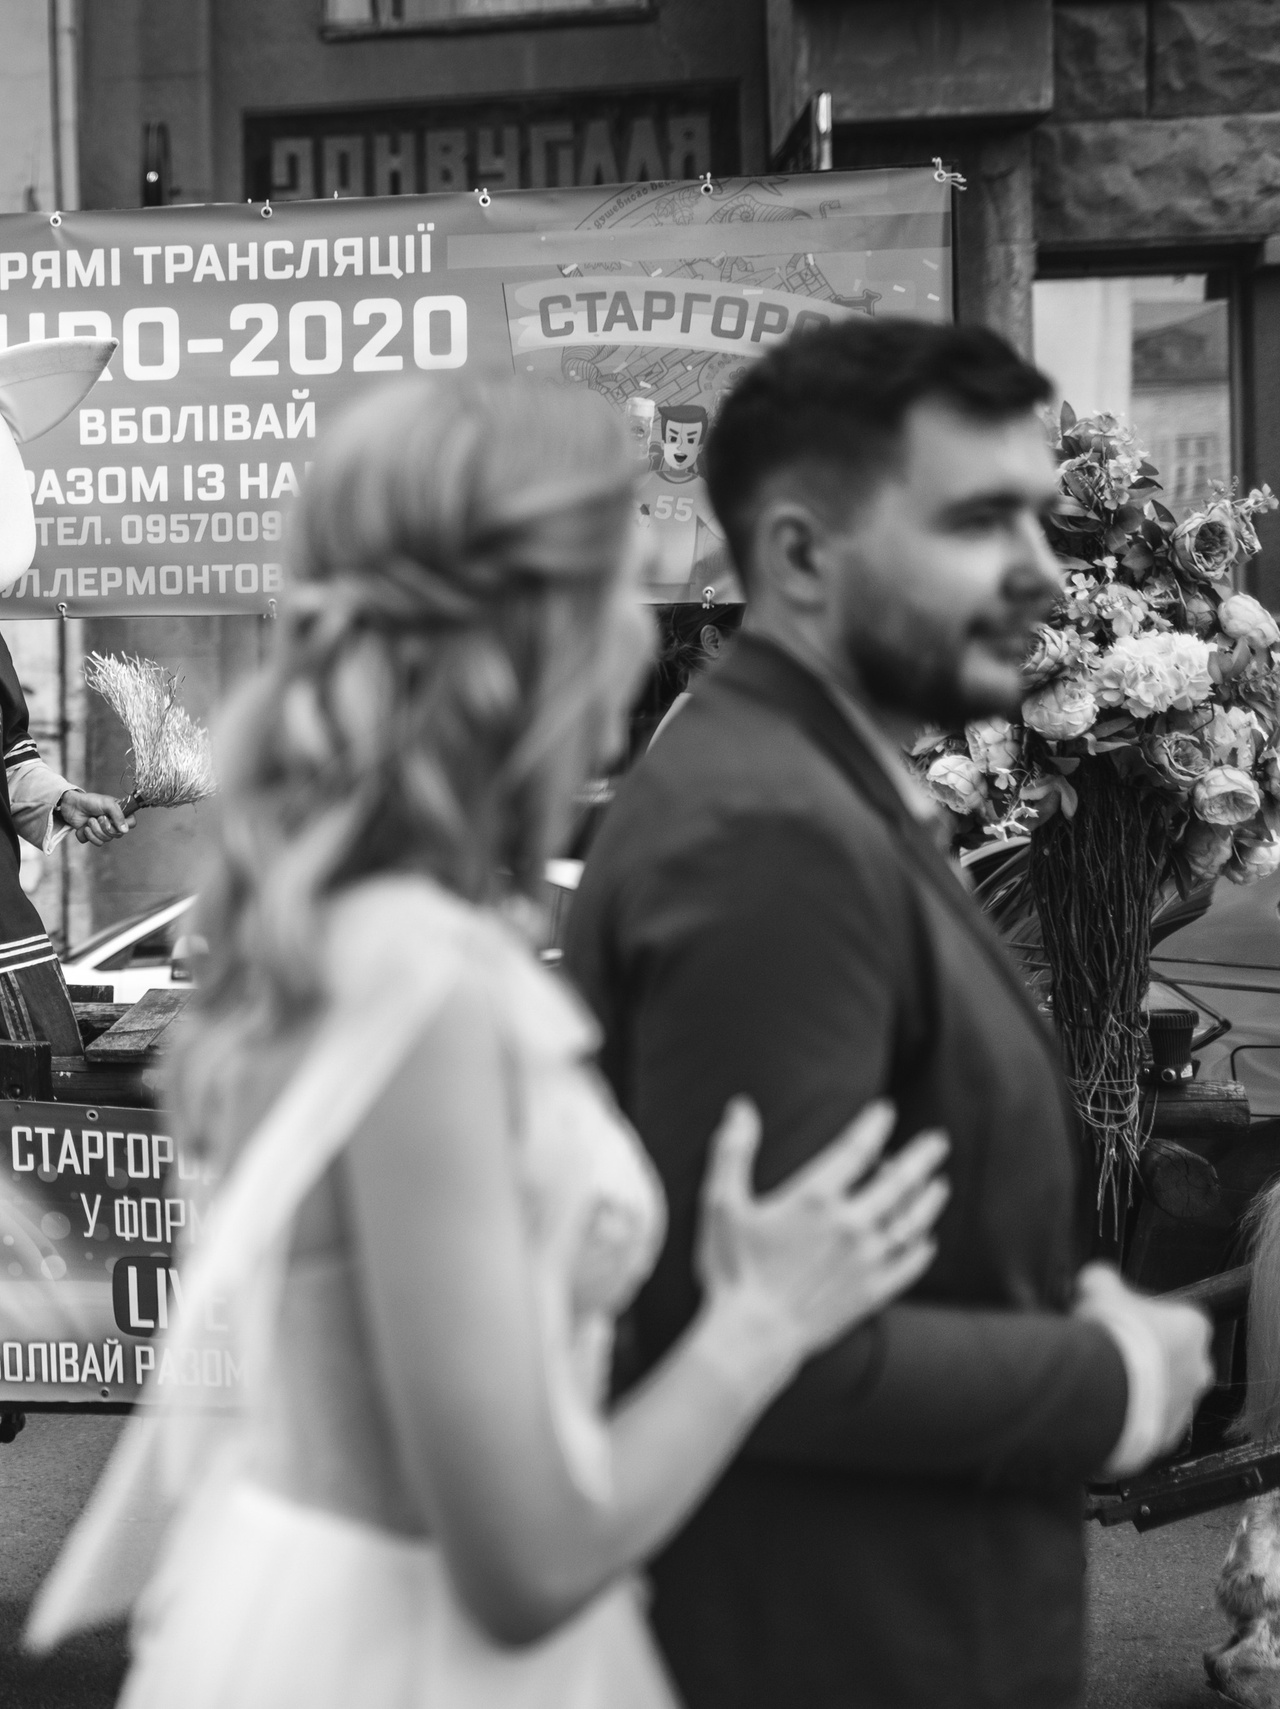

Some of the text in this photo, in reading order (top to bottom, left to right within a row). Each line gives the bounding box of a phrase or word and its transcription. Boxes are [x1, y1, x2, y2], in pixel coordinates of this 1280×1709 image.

[133, 223, 435, 285] ТРАНСЛЯЦІЇ
[79, 388, 317, 446] ВБОЛІВАЙ
[24, 461, 314, 506] АЗОМ ІЗ НА
[654, 494, 694, 522] 55
[34, 515, 112, 547] ТЕЛ.
[1, 562, 286, 599] Л.ЛЕРМОНТОВ
[79, 1192, 102, 1238] У
